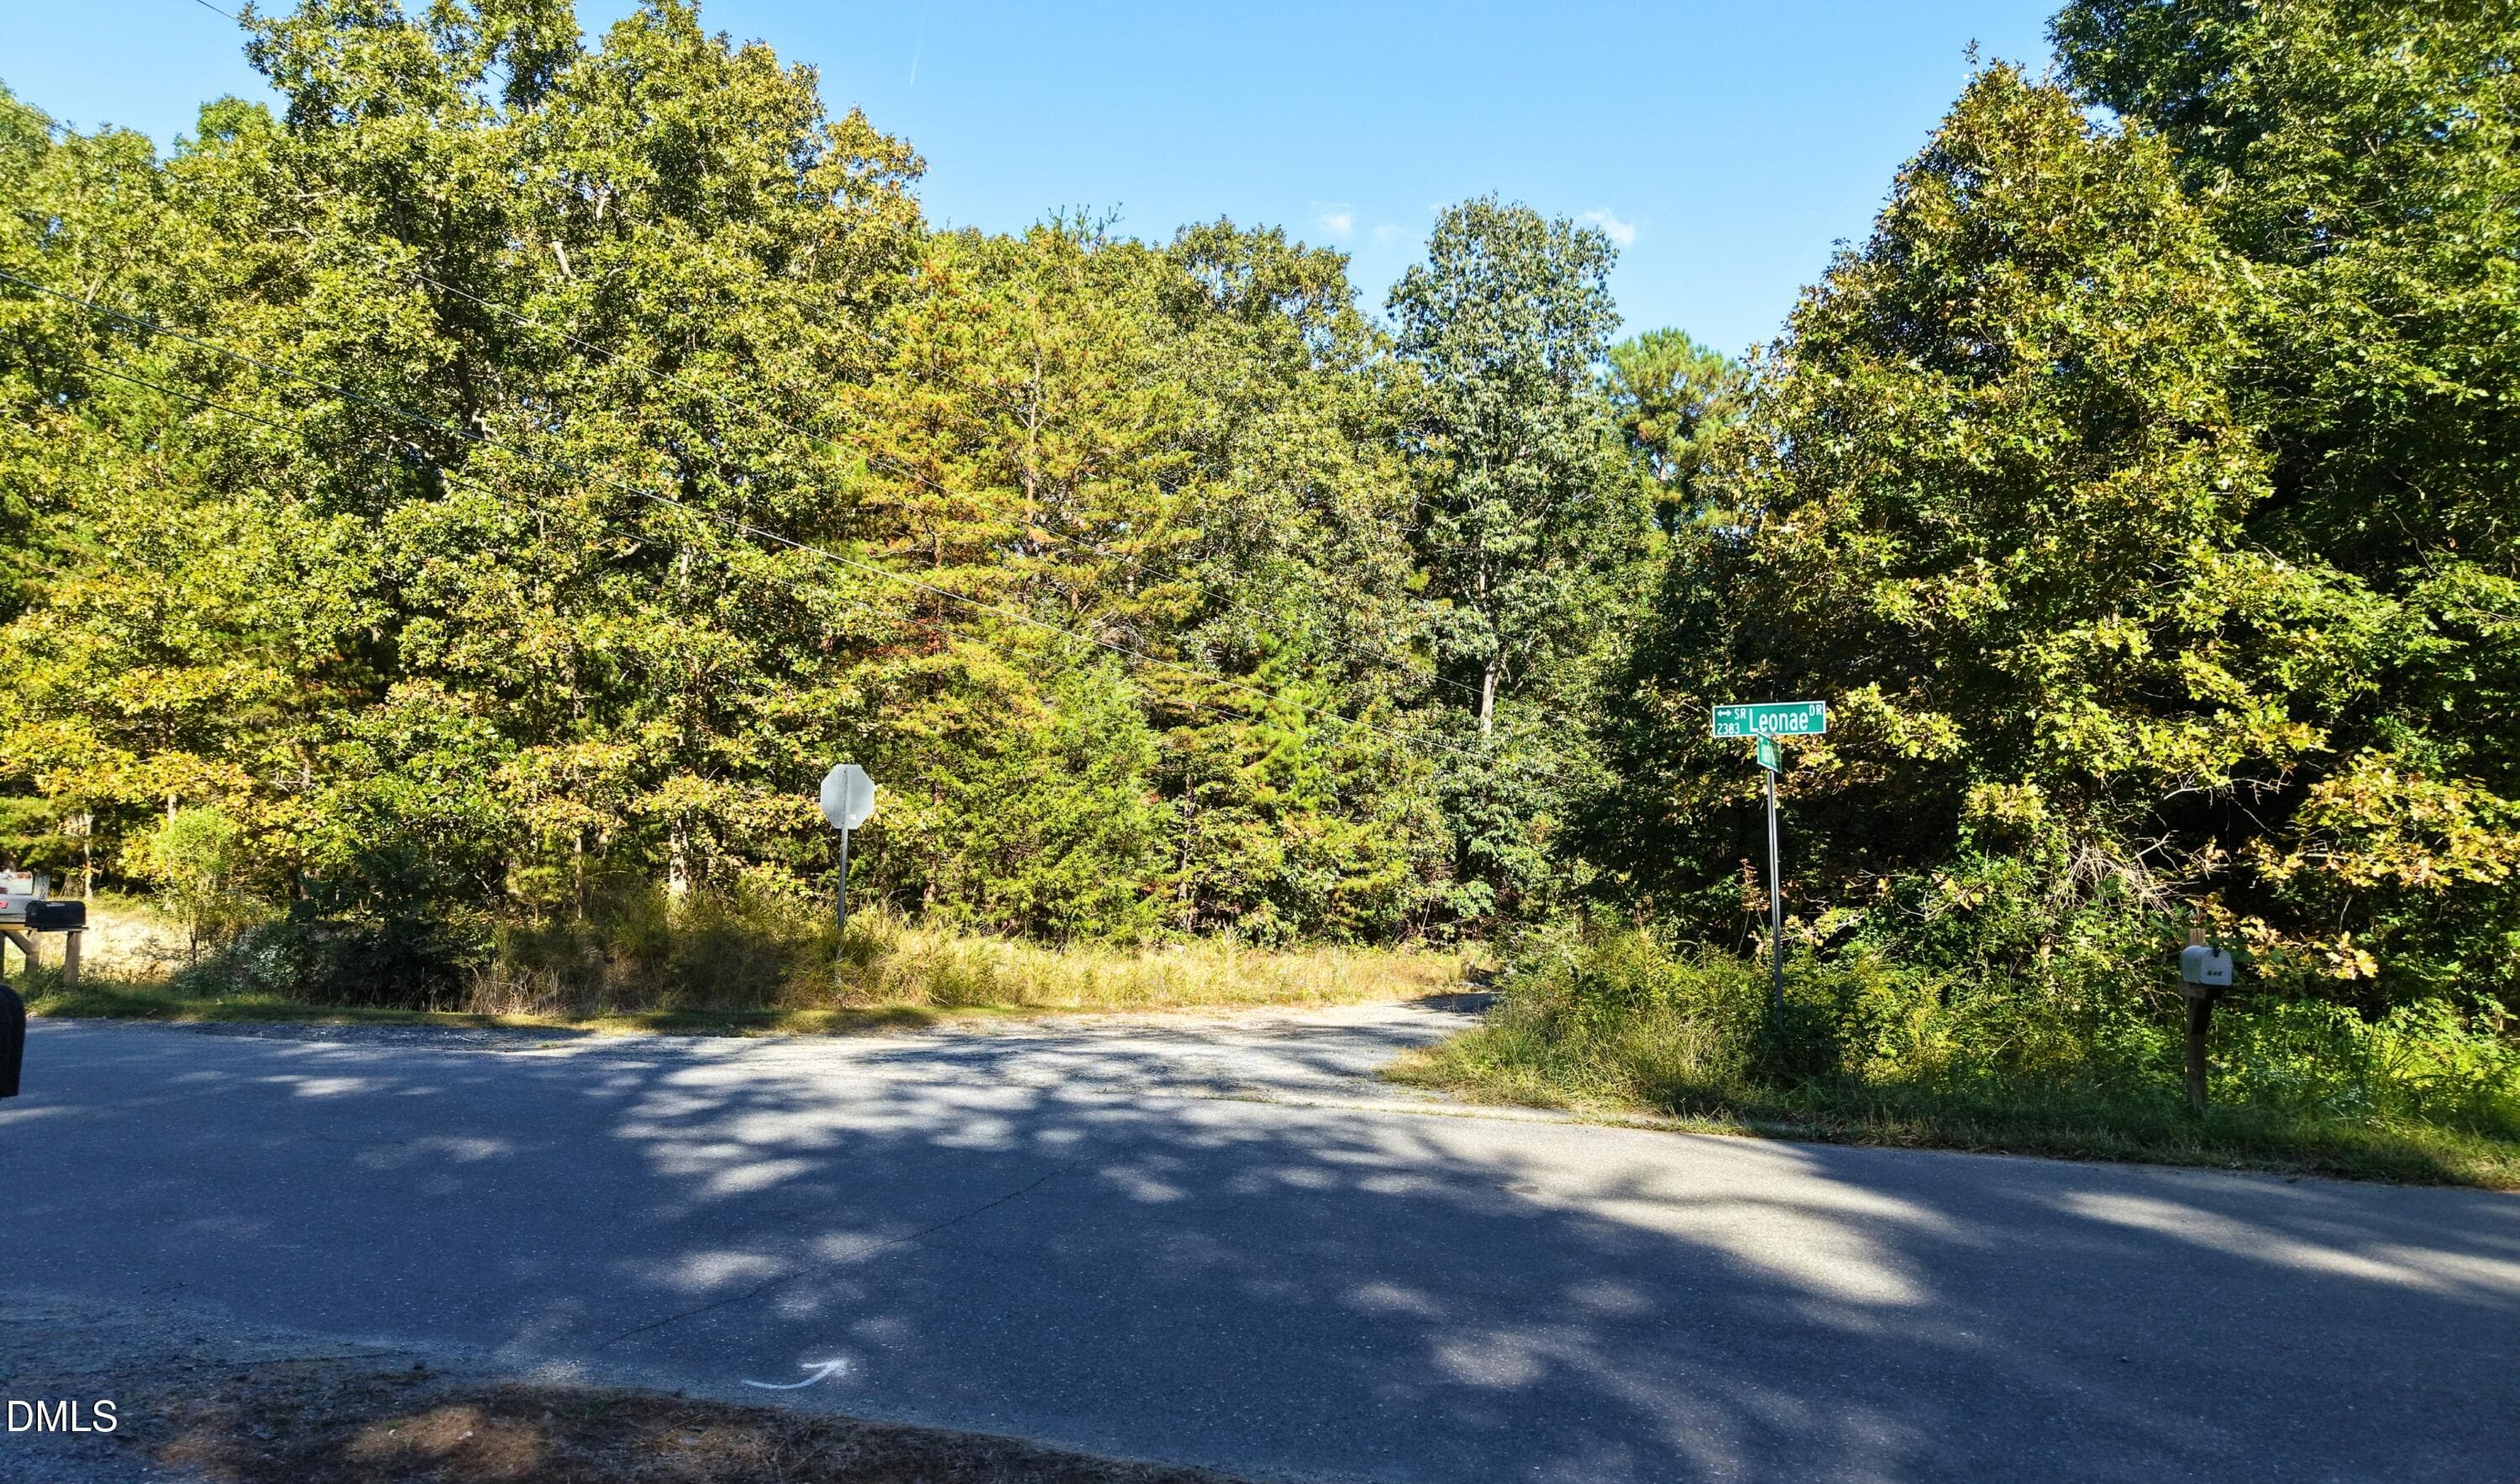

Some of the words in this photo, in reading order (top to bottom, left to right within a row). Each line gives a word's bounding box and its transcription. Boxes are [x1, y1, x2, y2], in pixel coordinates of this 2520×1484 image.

[1735, 709, 1746, 720] SR
[1750, 710, 1809, 732] Leonae
[1809, 705, 1822, 716] DR
[1717, 722, 1740, 734] 2383
